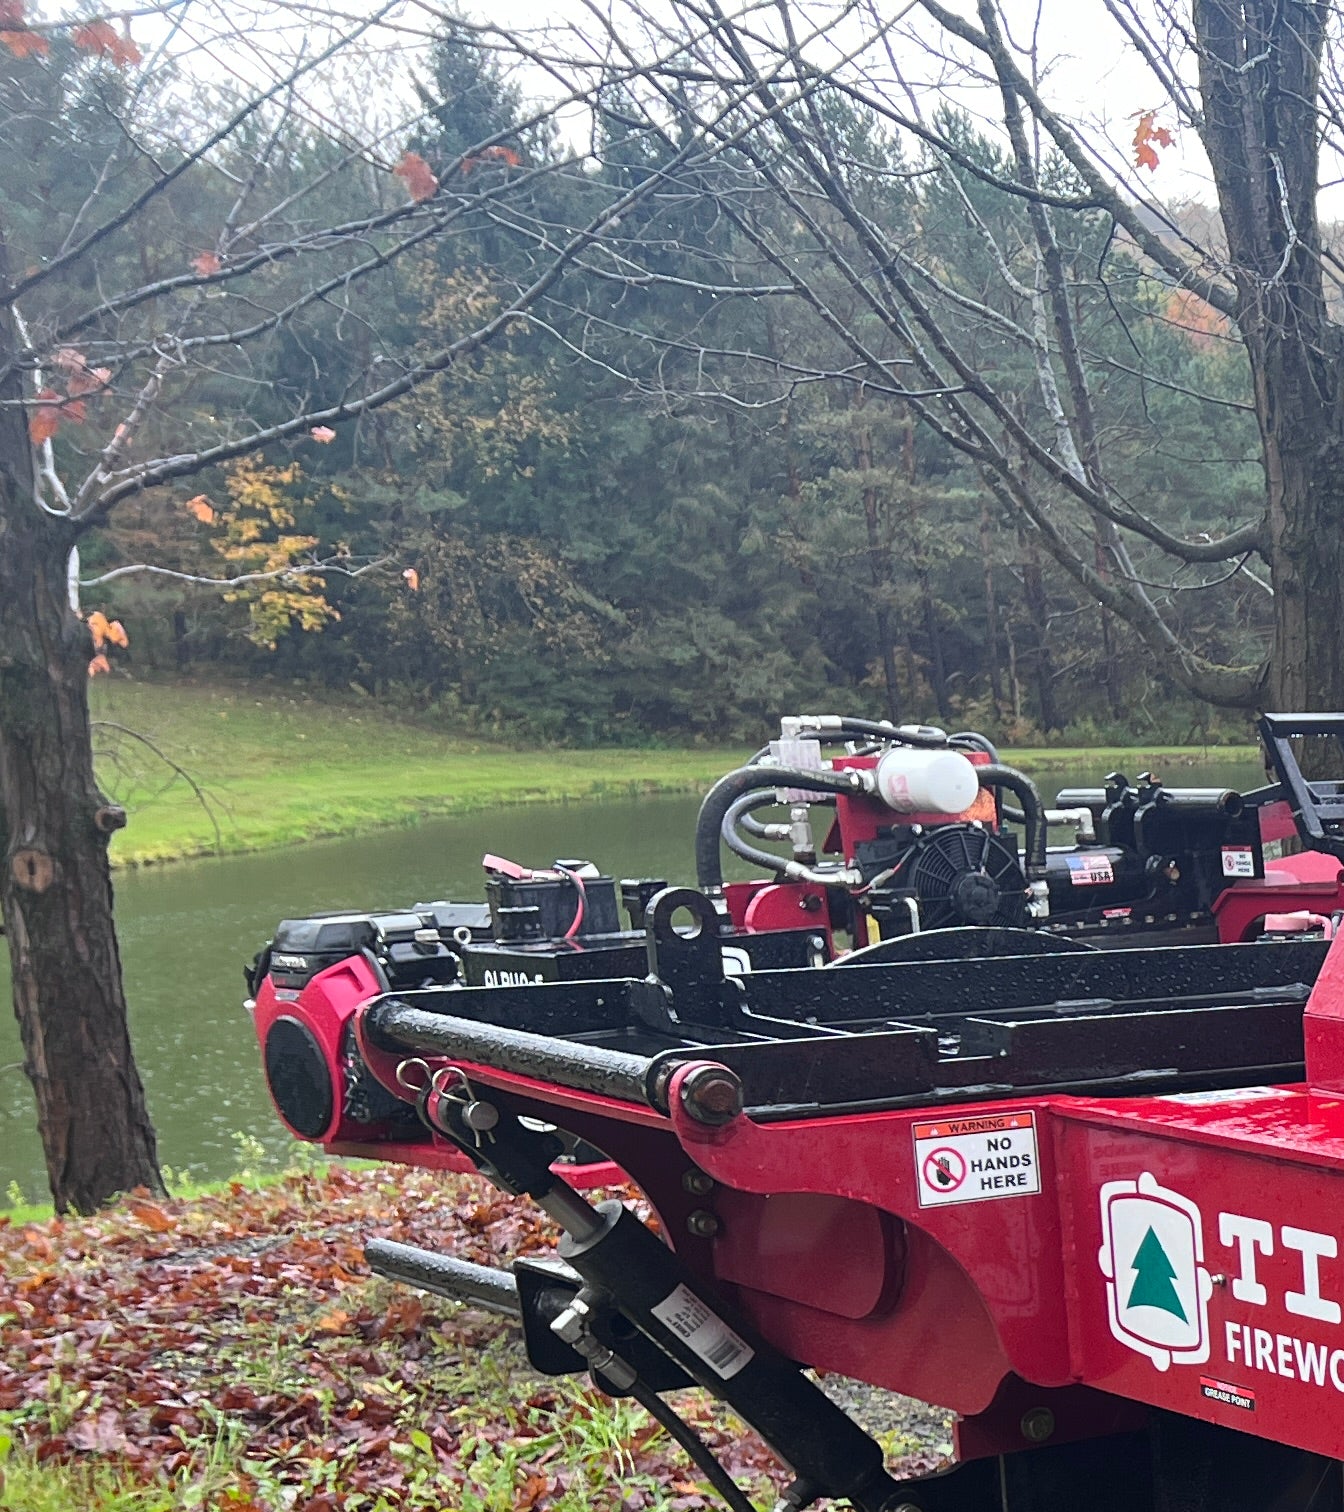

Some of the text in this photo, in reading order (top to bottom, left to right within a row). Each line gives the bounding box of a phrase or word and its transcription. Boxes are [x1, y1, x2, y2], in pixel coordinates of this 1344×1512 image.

[1090, 871, 1112, 882] USA
[948, 1118, 1005, 1134] WARNING
[987, 1137, 1012, 1152] NO
[970, 1153, 1032, 1173] HANDS
[980, 1173, 1028, 1191] HERE
